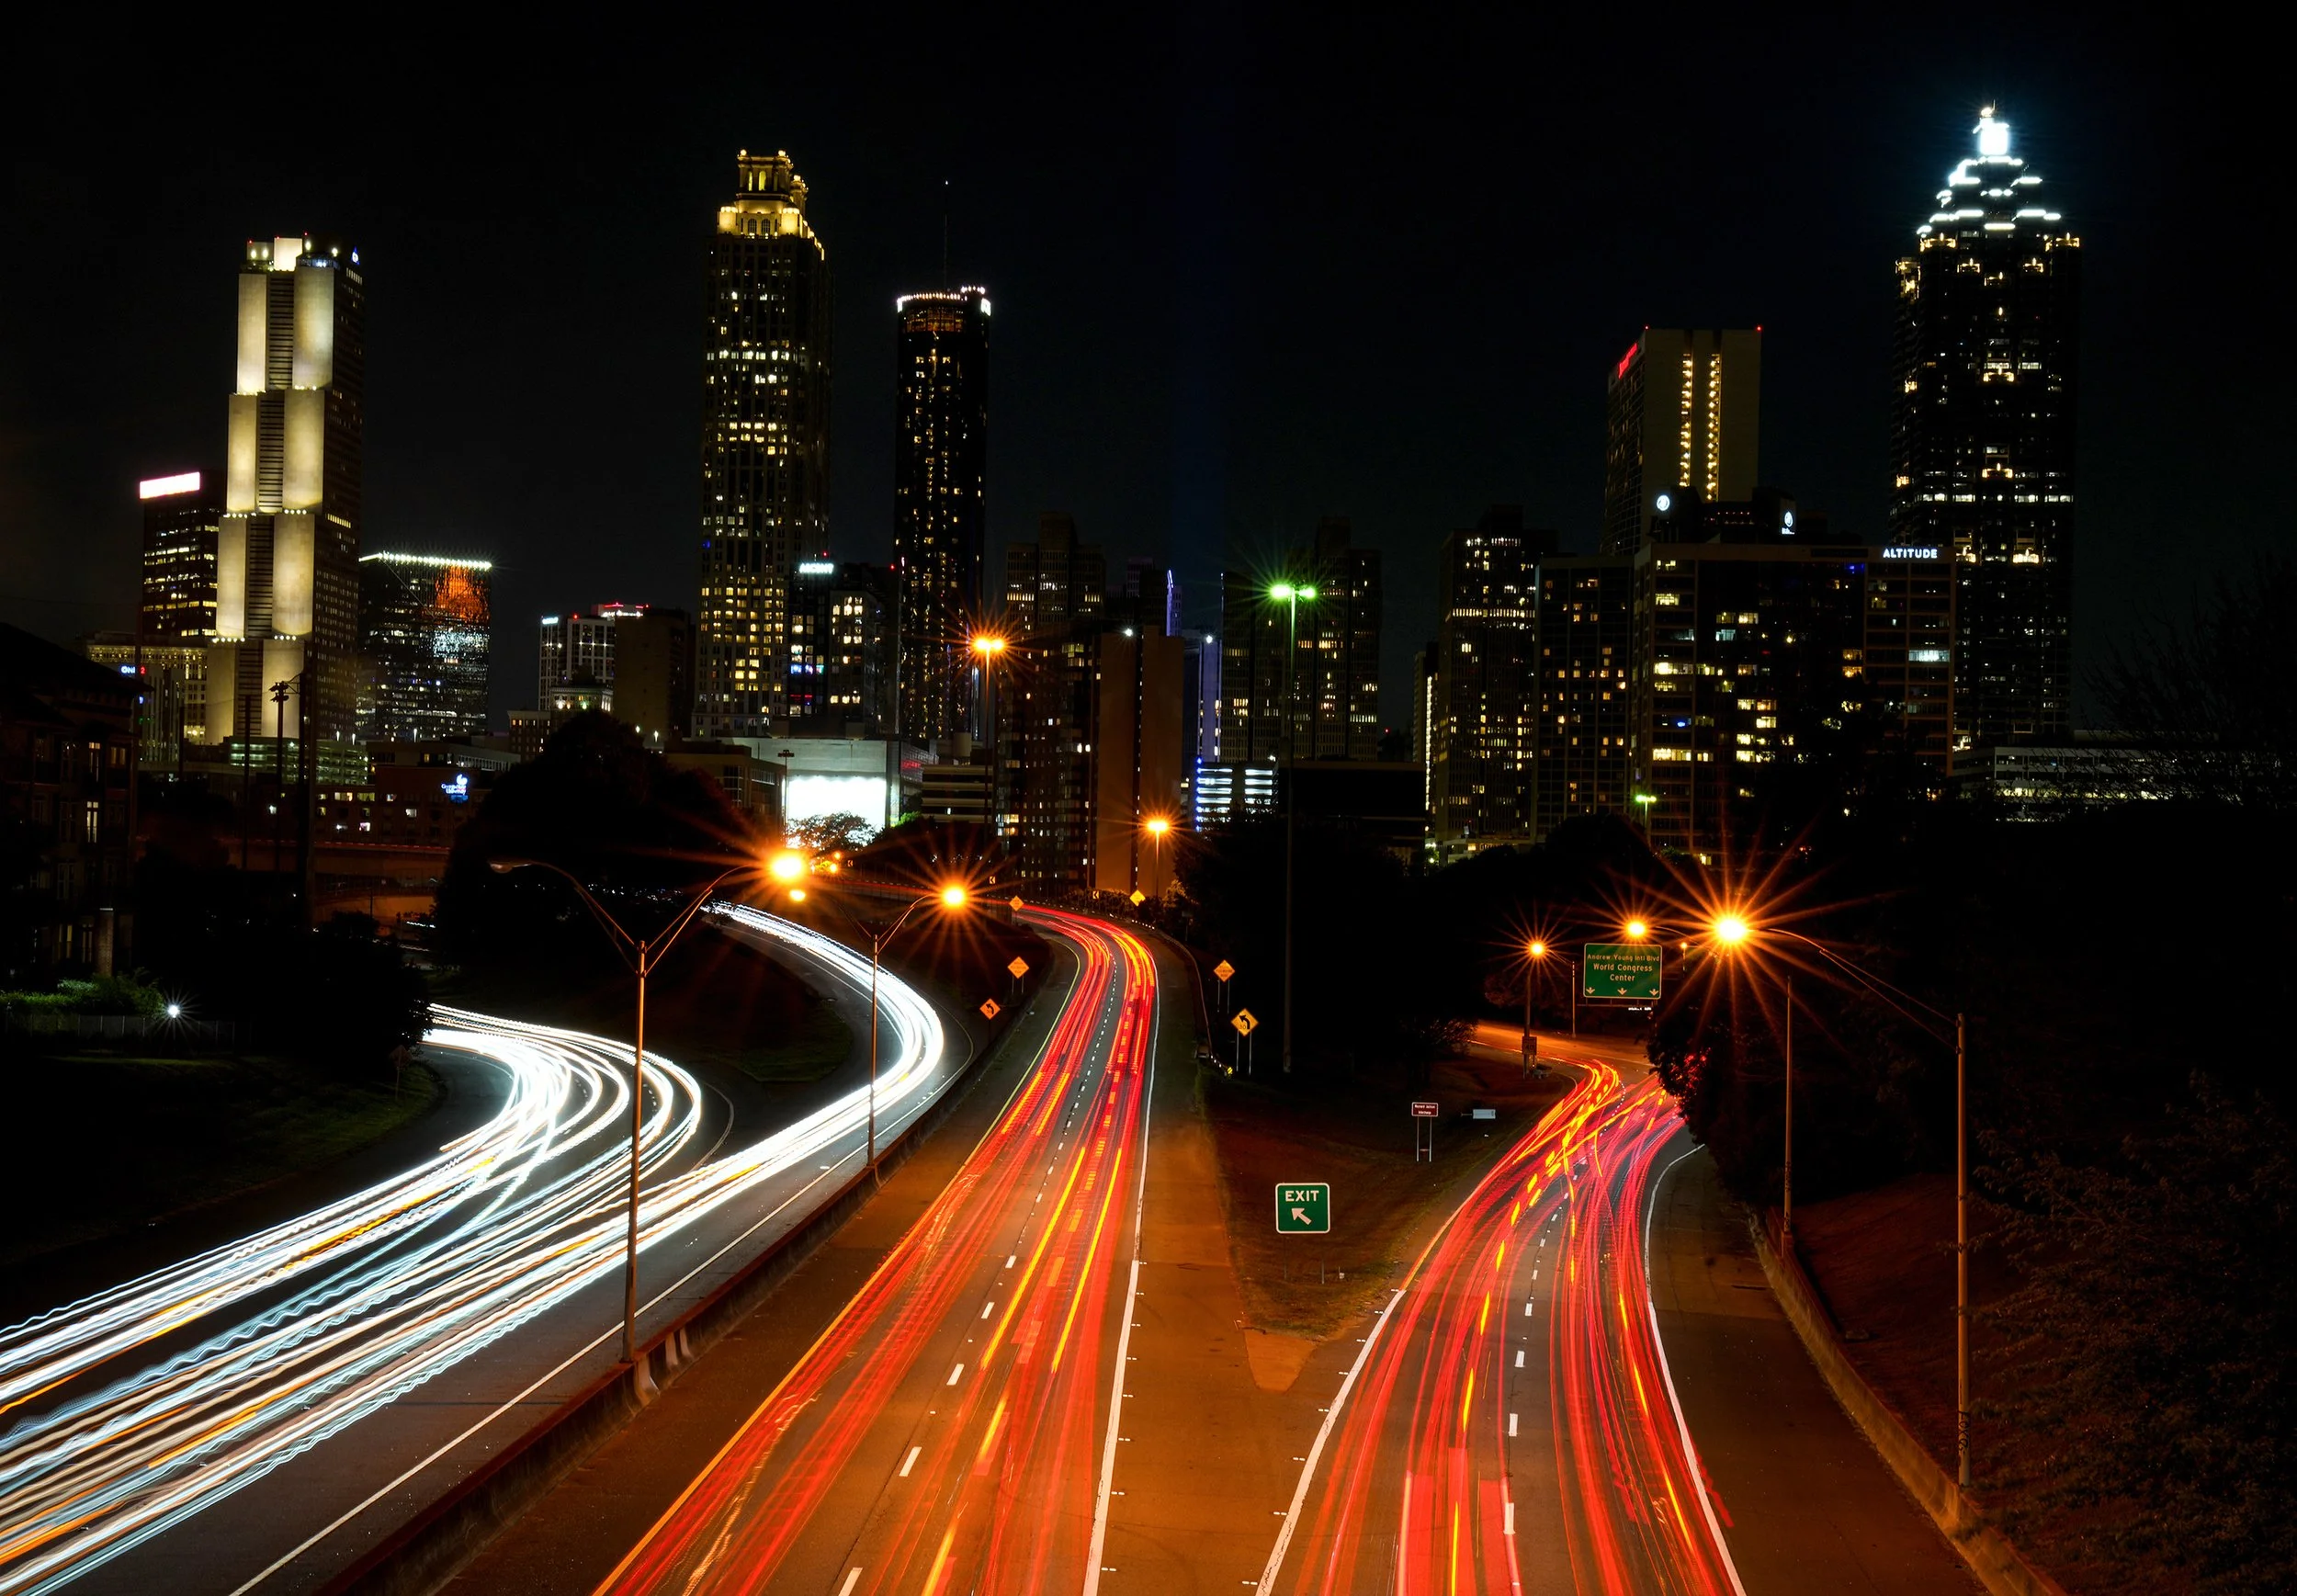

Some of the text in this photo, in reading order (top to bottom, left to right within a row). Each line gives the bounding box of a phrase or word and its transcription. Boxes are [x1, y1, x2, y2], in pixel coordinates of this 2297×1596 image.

[1883, 549, 1938, 559] ALTITUDE
[1613, 954, 1634, 962] Young
[1593, 963, 1653, 973] World Congress
[1284, 1190, 1319, 1202] EXIT
